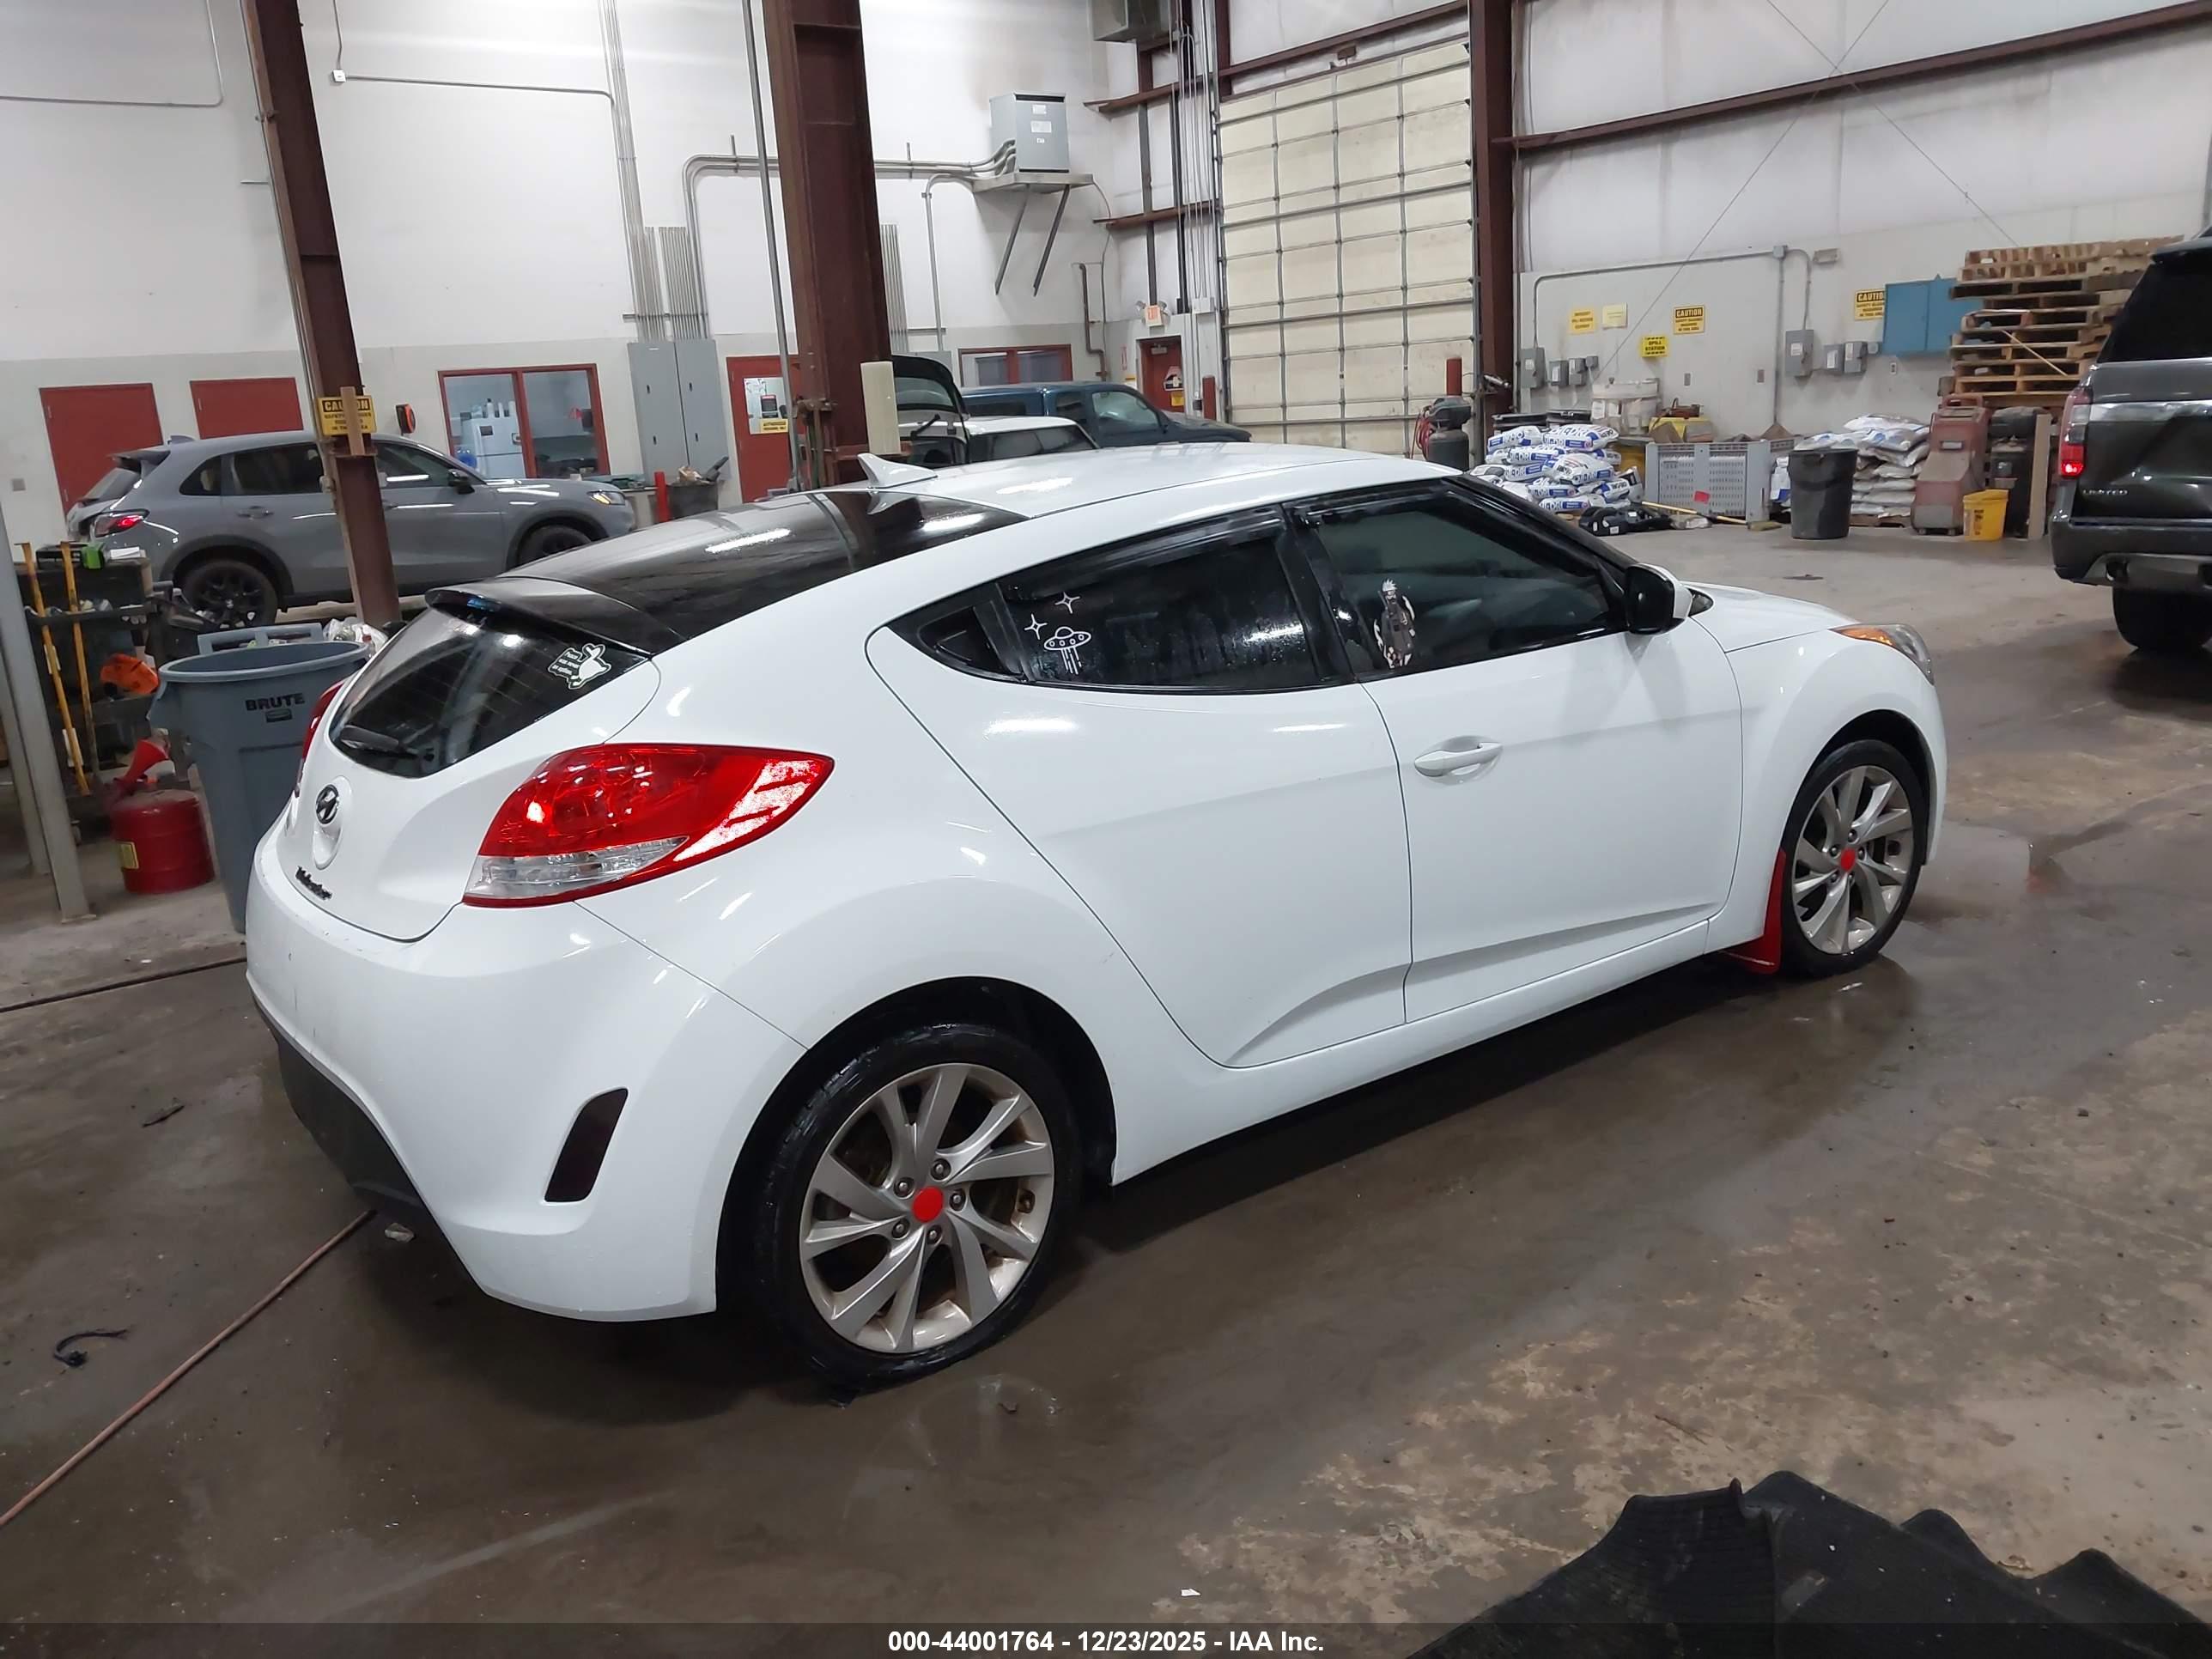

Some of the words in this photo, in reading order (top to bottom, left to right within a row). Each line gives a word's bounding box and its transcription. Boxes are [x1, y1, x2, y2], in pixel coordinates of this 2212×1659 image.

[1857, 292, 1883, 301] CAUTIO
[1676, 308, 1702, 317] CAUTION
[246, 692, 306, 711] BRUTE
